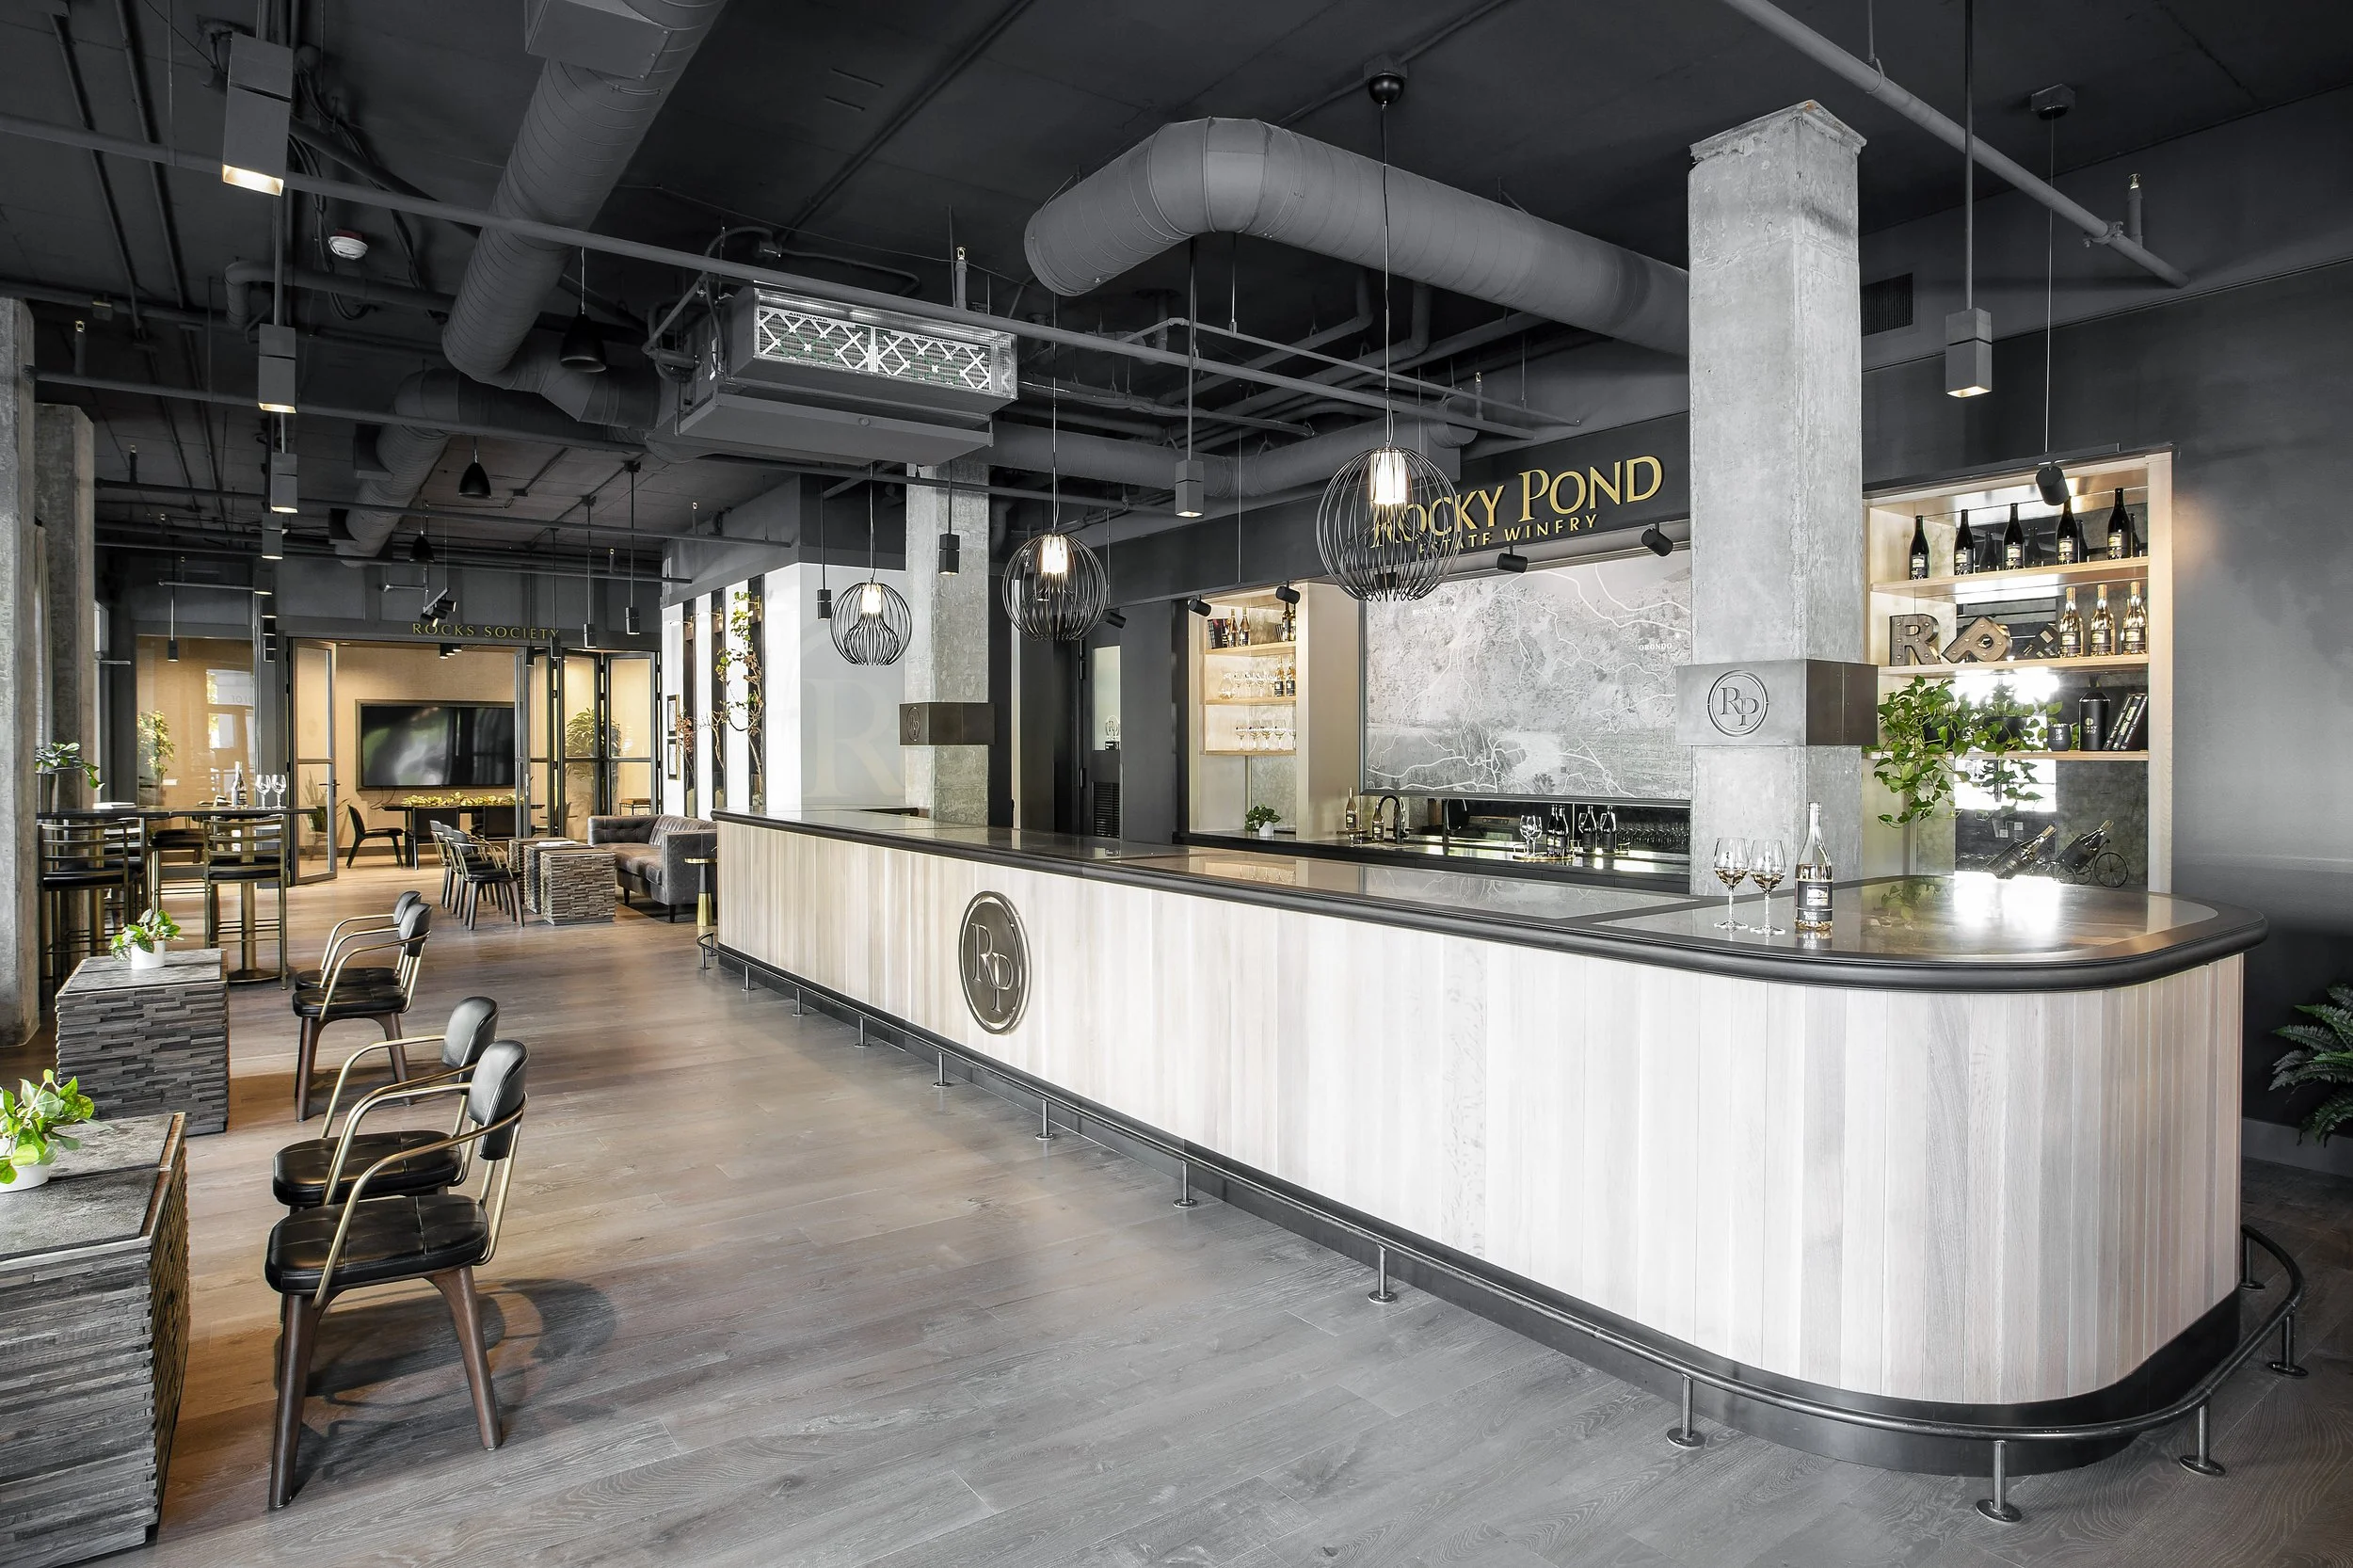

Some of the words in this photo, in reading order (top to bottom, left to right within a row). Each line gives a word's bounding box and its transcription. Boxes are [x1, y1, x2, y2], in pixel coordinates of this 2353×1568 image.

[788, 312, 828, 322] AIRGUARD
[1518, 456, 1663, 522] POND
[412, 623, 474, 637] ROCKS
[484, 626, 559, 639] SOCIETY
[1639, 642, 1673, 650] ORONDO
